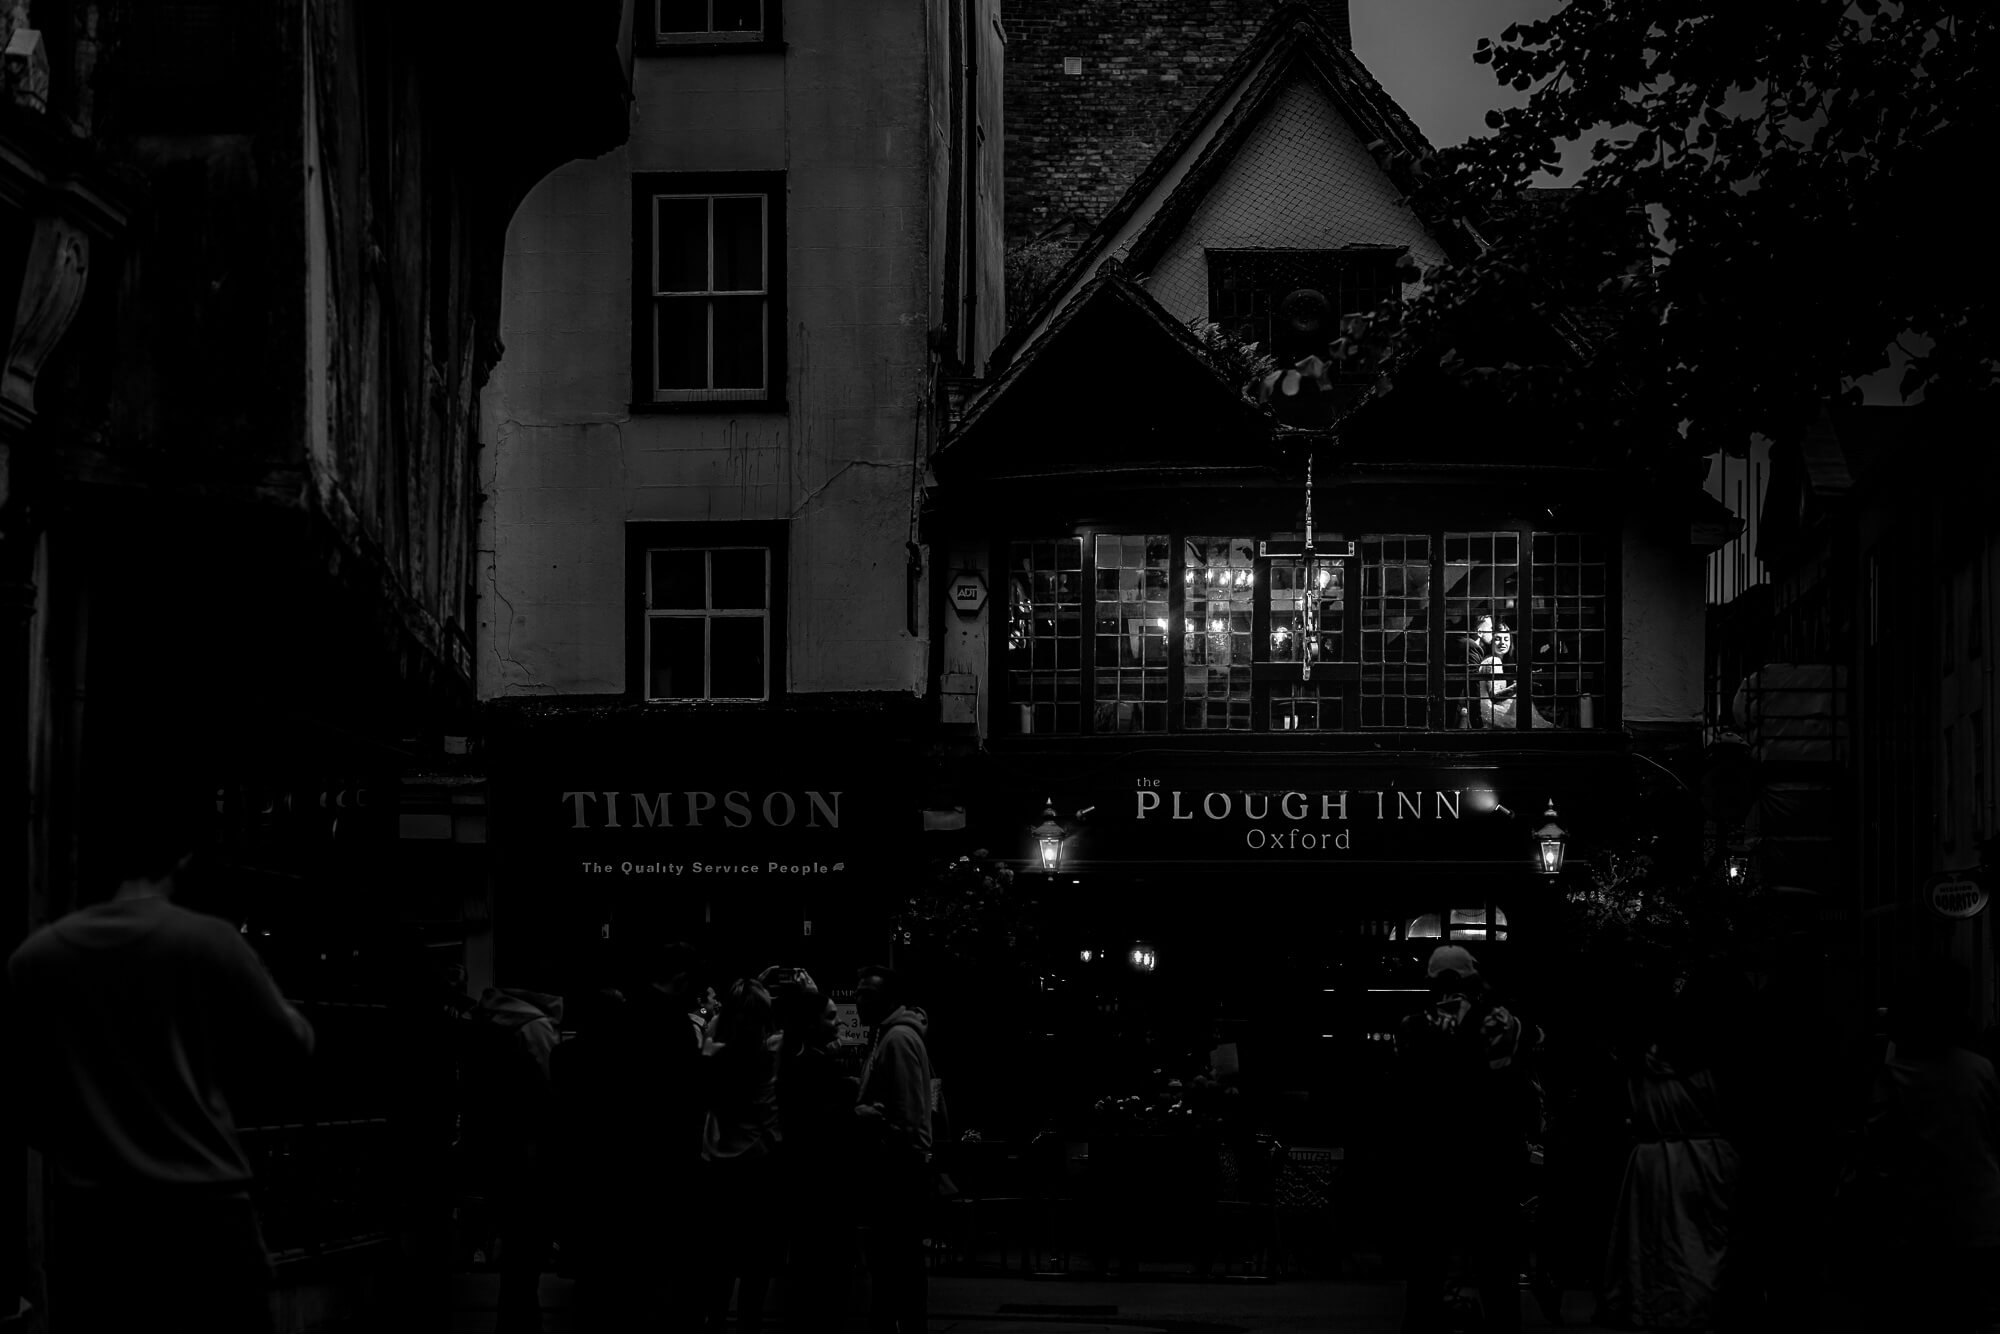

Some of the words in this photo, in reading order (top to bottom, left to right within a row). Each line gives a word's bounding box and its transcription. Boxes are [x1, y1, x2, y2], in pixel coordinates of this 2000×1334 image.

[957, 588, 977, 599] ADT
[1137, 778, 1161, 788] the
[562, 790, 843, 828] TIMPSON
[1136, 791, 1348, 820] PLOUGH
[1377, 791, 1461, 820] INN
[1247, 828, 1350, 850] Oxford
[582, 862, 613, 873] The
[621, 861, 684, 876] Quality
[692, 861, 759, 873] Service
[768, 862, 828, 876] People
[1935, 892, 1979, 911] BURRITO
[845, 1030, 861, 1039] Key
